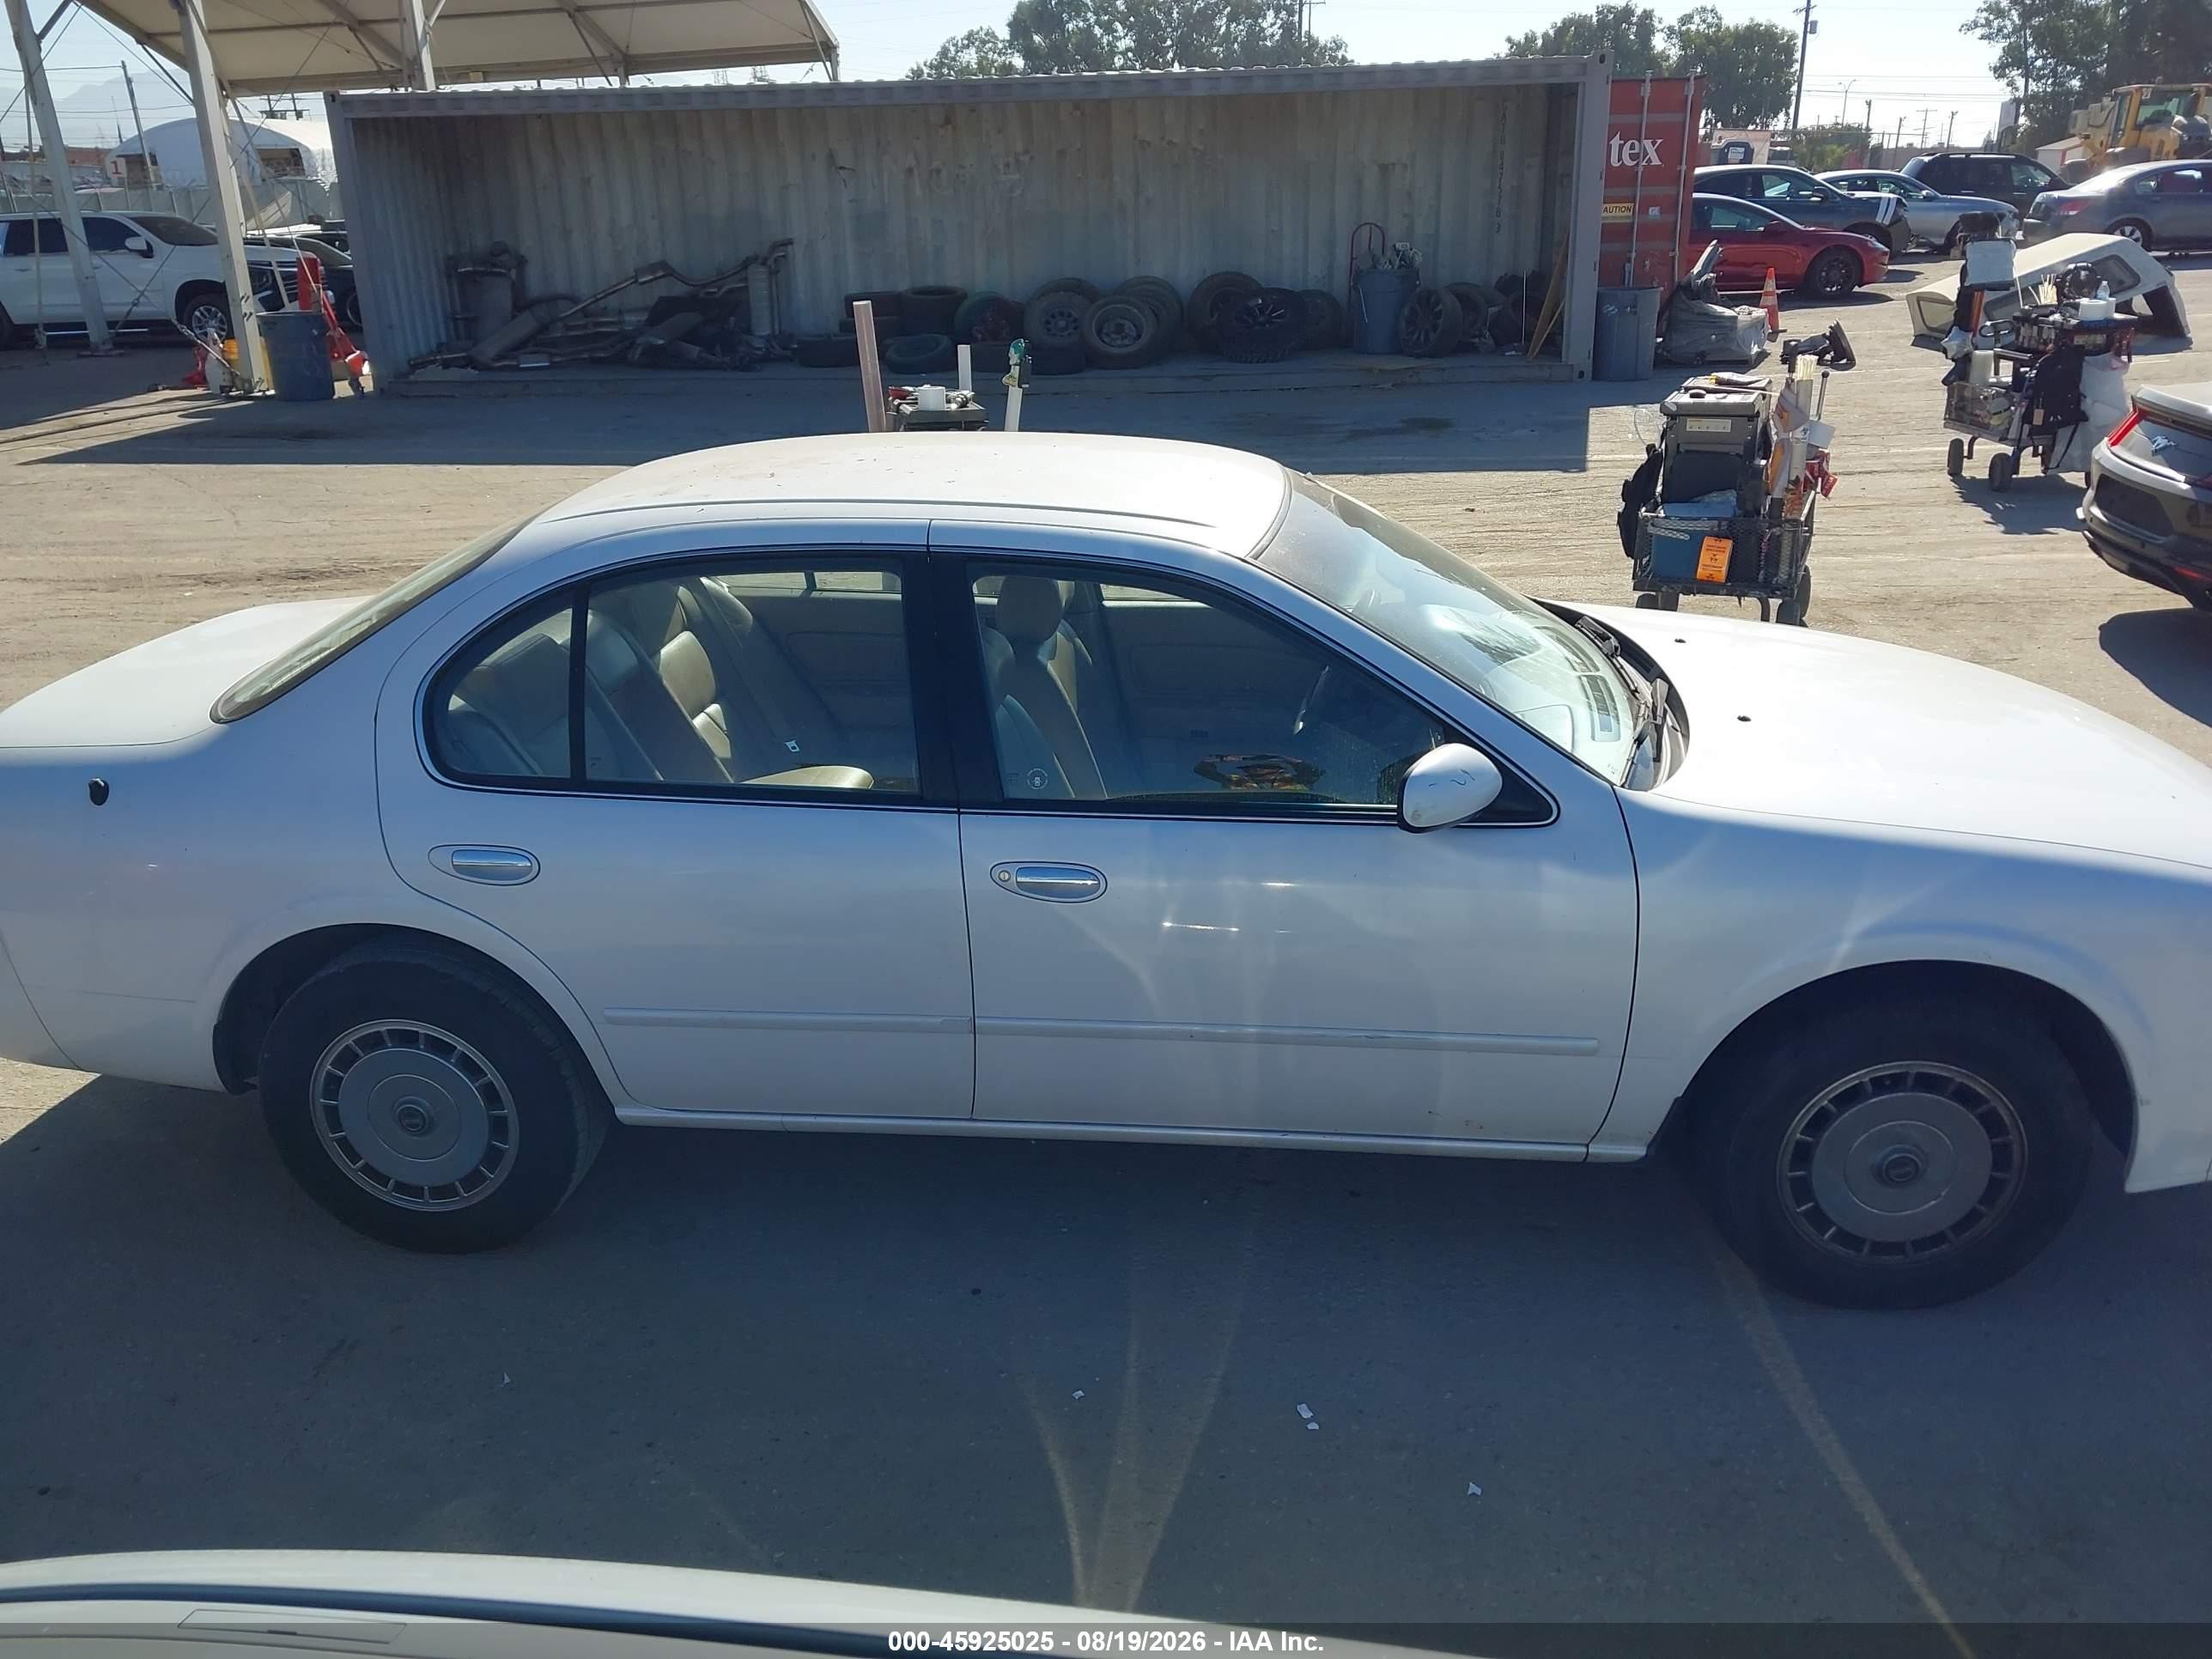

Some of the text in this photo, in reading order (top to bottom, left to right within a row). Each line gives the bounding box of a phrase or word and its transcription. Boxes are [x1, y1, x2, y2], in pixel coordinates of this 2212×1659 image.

[1608, 131, 1663, 167] tex
[109, 160, 122, 175] 1
[1602, 205, 1632, 214] AUTION
